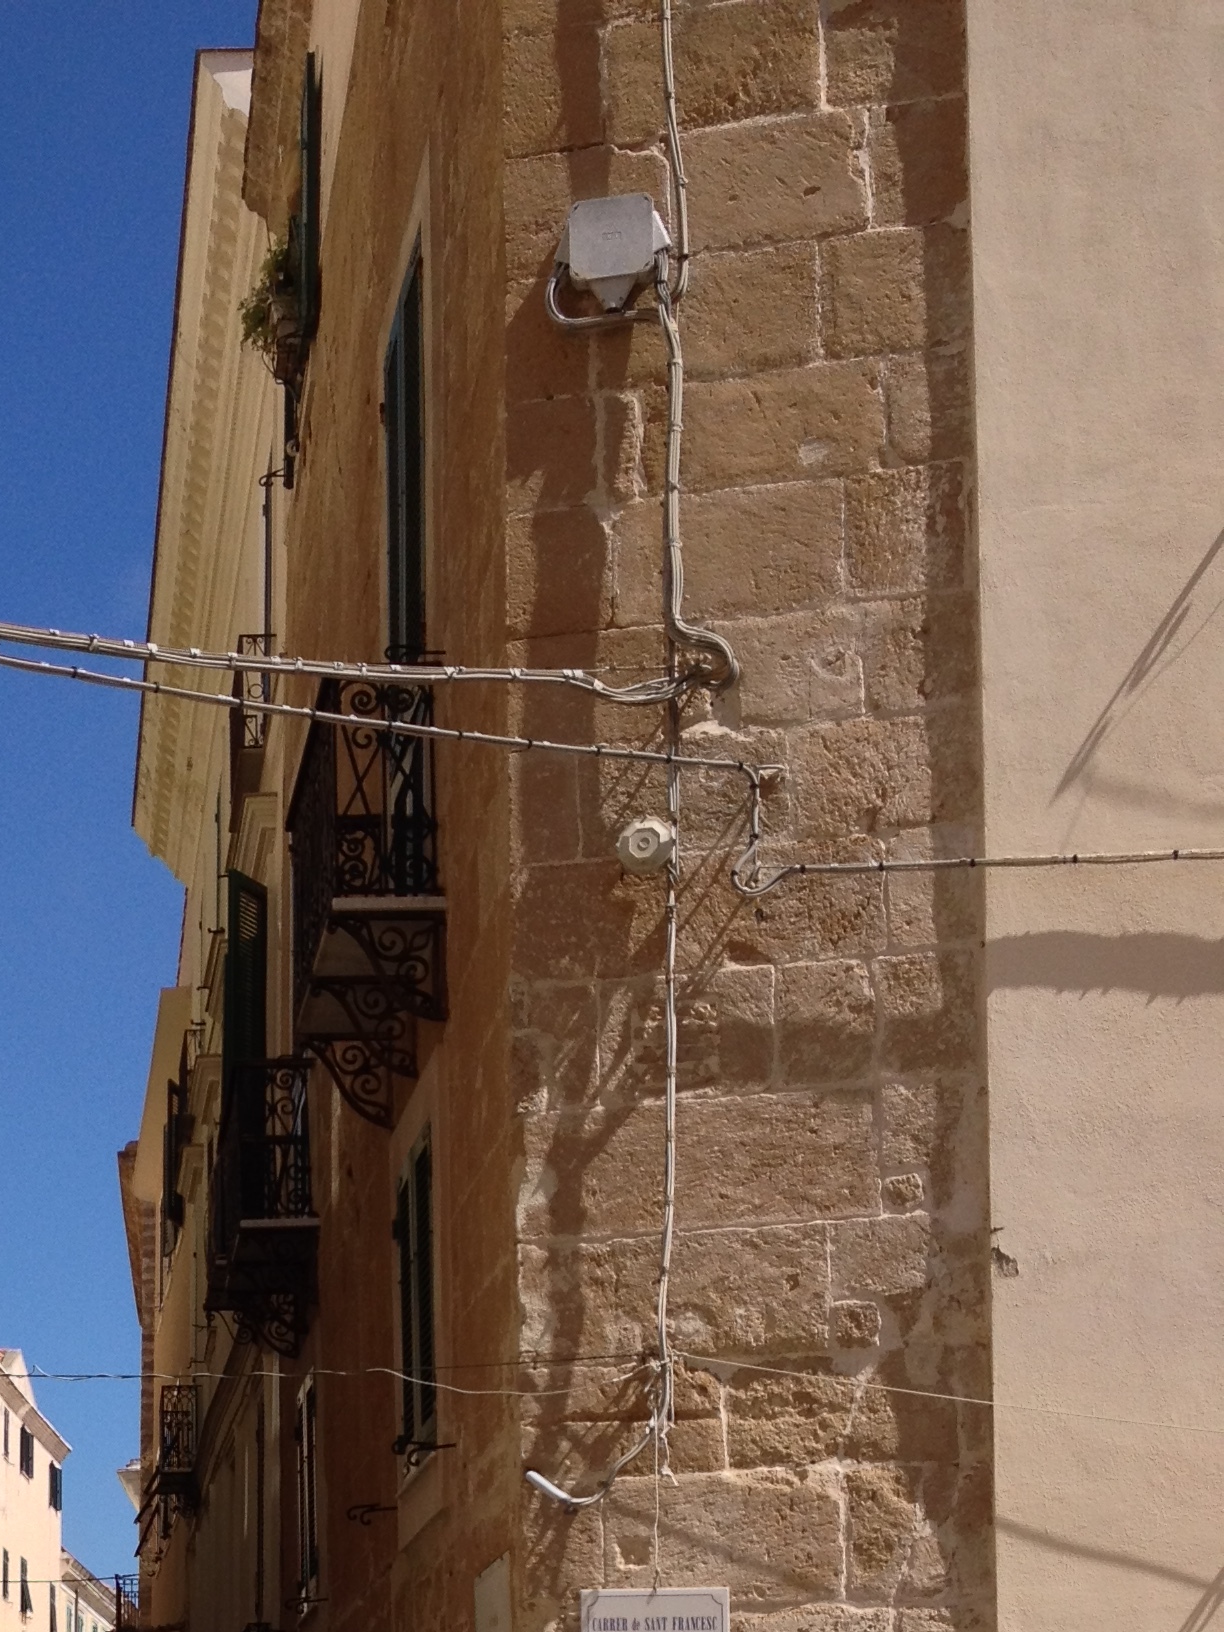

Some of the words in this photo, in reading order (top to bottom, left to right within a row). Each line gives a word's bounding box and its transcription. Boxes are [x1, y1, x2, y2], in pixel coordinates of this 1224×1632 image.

[592, 1617, 628, 1631] CARRER
[644, 1616, 668, 1631] SANT
[672, 1615, 718, 1631] FRANCESC
